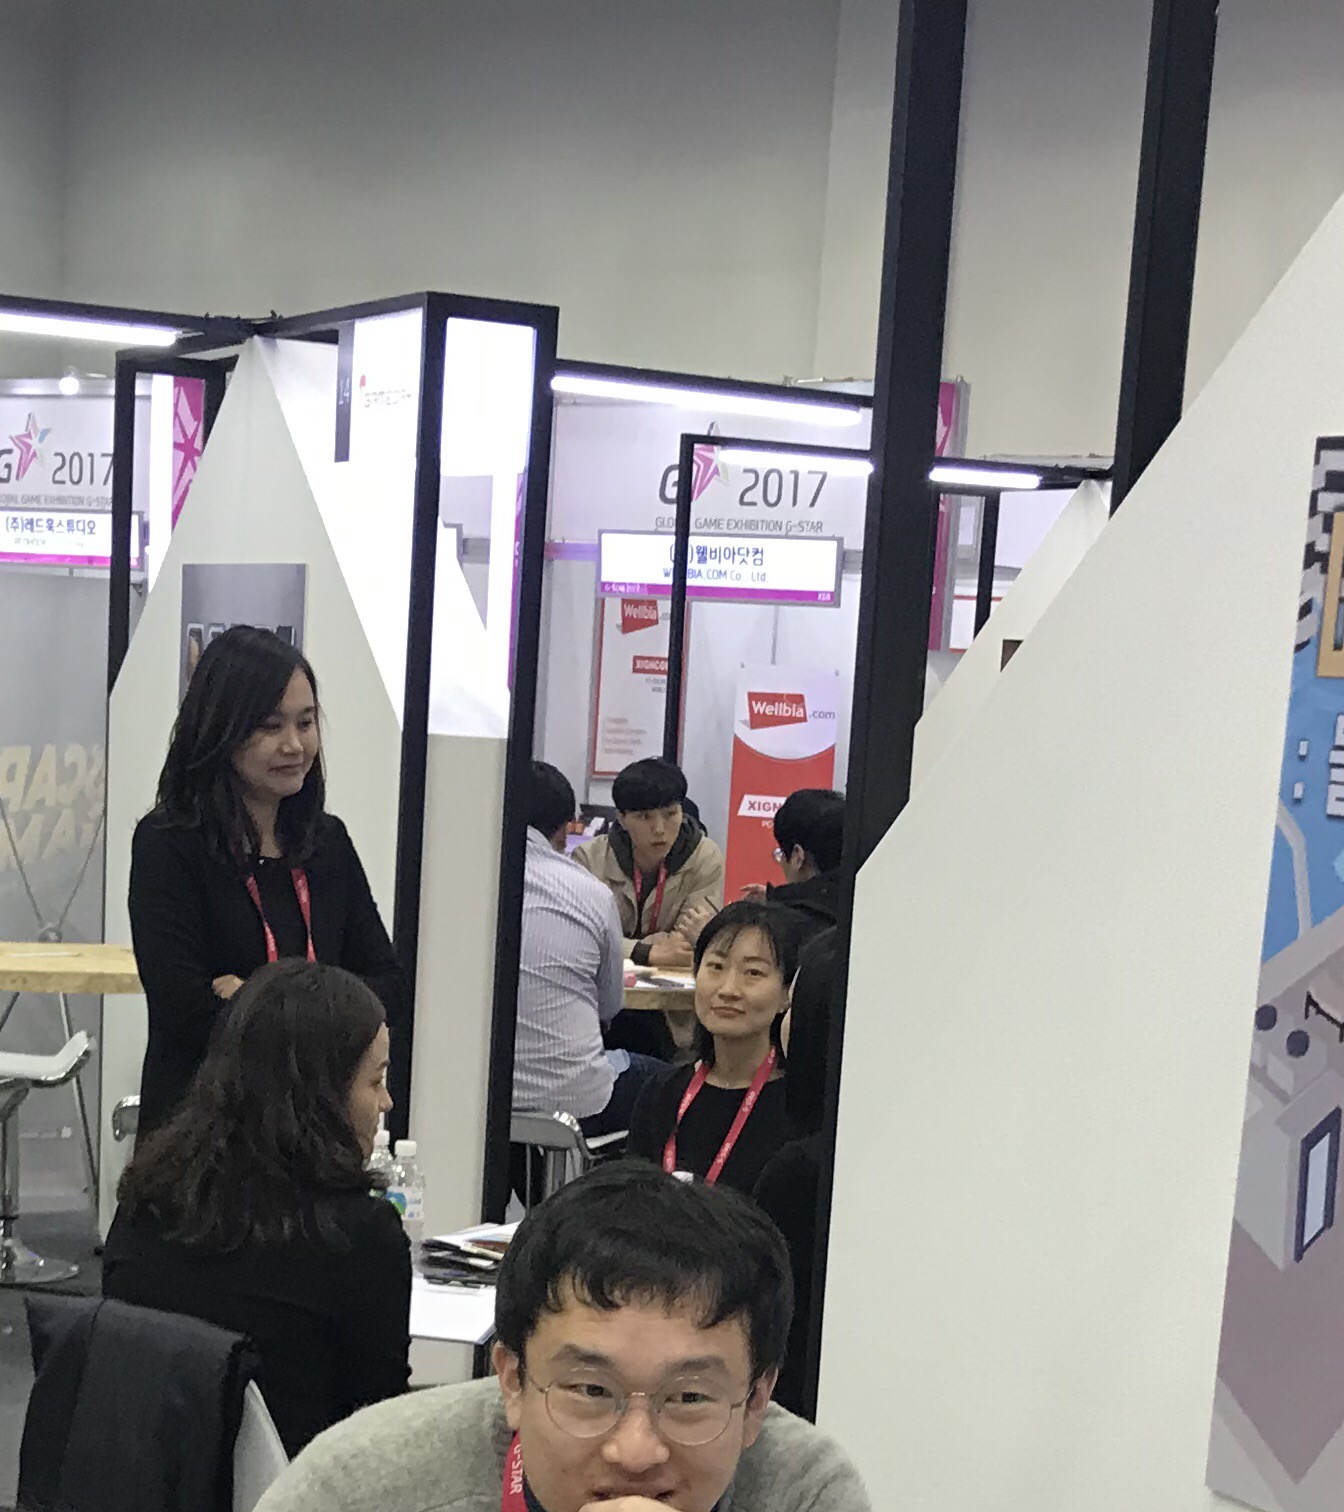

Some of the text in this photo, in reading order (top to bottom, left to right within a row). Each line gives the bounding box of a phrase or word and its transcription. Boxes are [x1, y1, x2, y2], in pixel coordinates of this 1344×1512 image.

[51, 452, 114, 486] 2017
[739, 468, 828, 508] 2017
[21, 494, 43, 505] GAME
[44, 494, 85, 506] EXHIBITION
[85, 495, 113, 507] G-STA
[694, 517, 724, 530] GAME
[726, 518, 783, 532] EXHIBITION
[785, 520, 824, 534] G-STAR
[669, 544, 765, 567] ()웰비아닷컴
[663, 566, 728, 581] WBIA.COM
[751, 700, 804, 719] Wellbia
[509, 1443, 523, 1495] G-STAR
